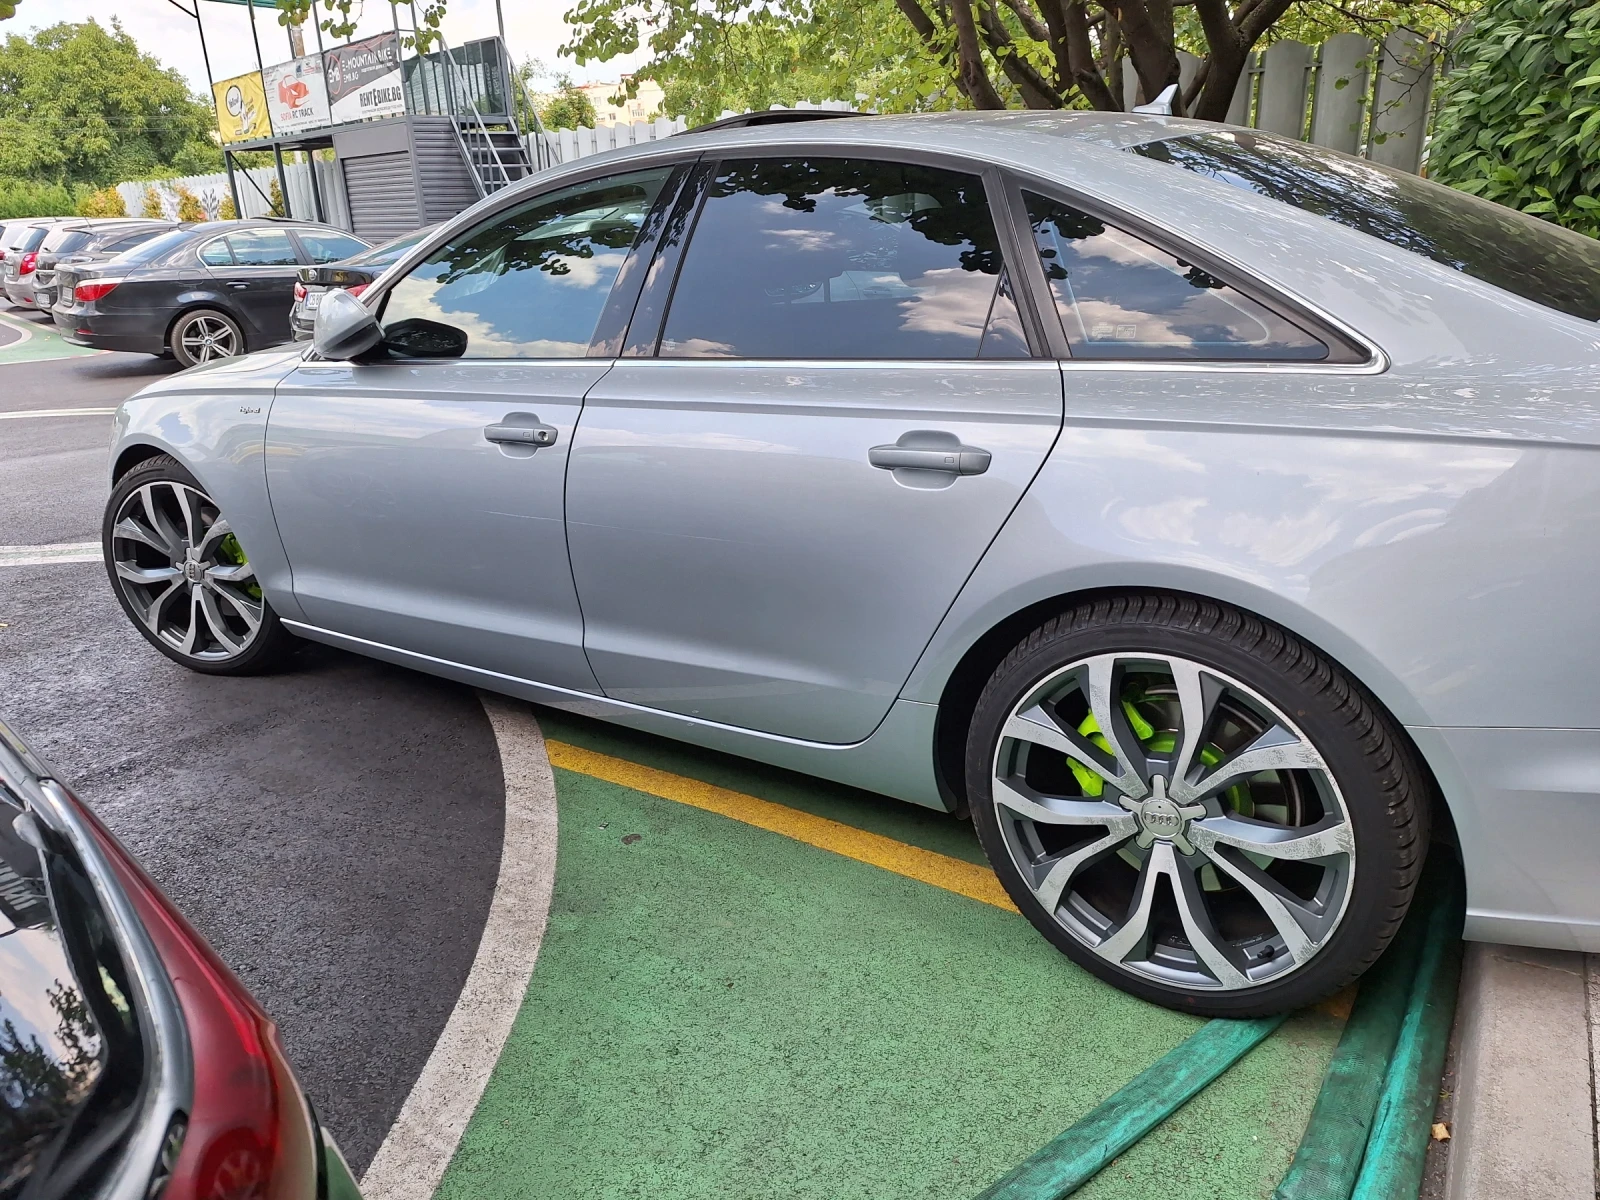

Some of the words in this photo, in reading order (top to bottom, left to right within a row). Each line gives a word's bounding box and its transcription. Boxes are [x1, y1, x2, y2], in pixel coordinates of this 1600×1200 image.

[342, 52, 379, 71] E-MOUNTAIN
[377, 47, 392, 62] BIKE
[280, 111, 293, 121] SOFIA
[292, 109, 299, 119] RC
[299, 107, 314, 118] TRACK
